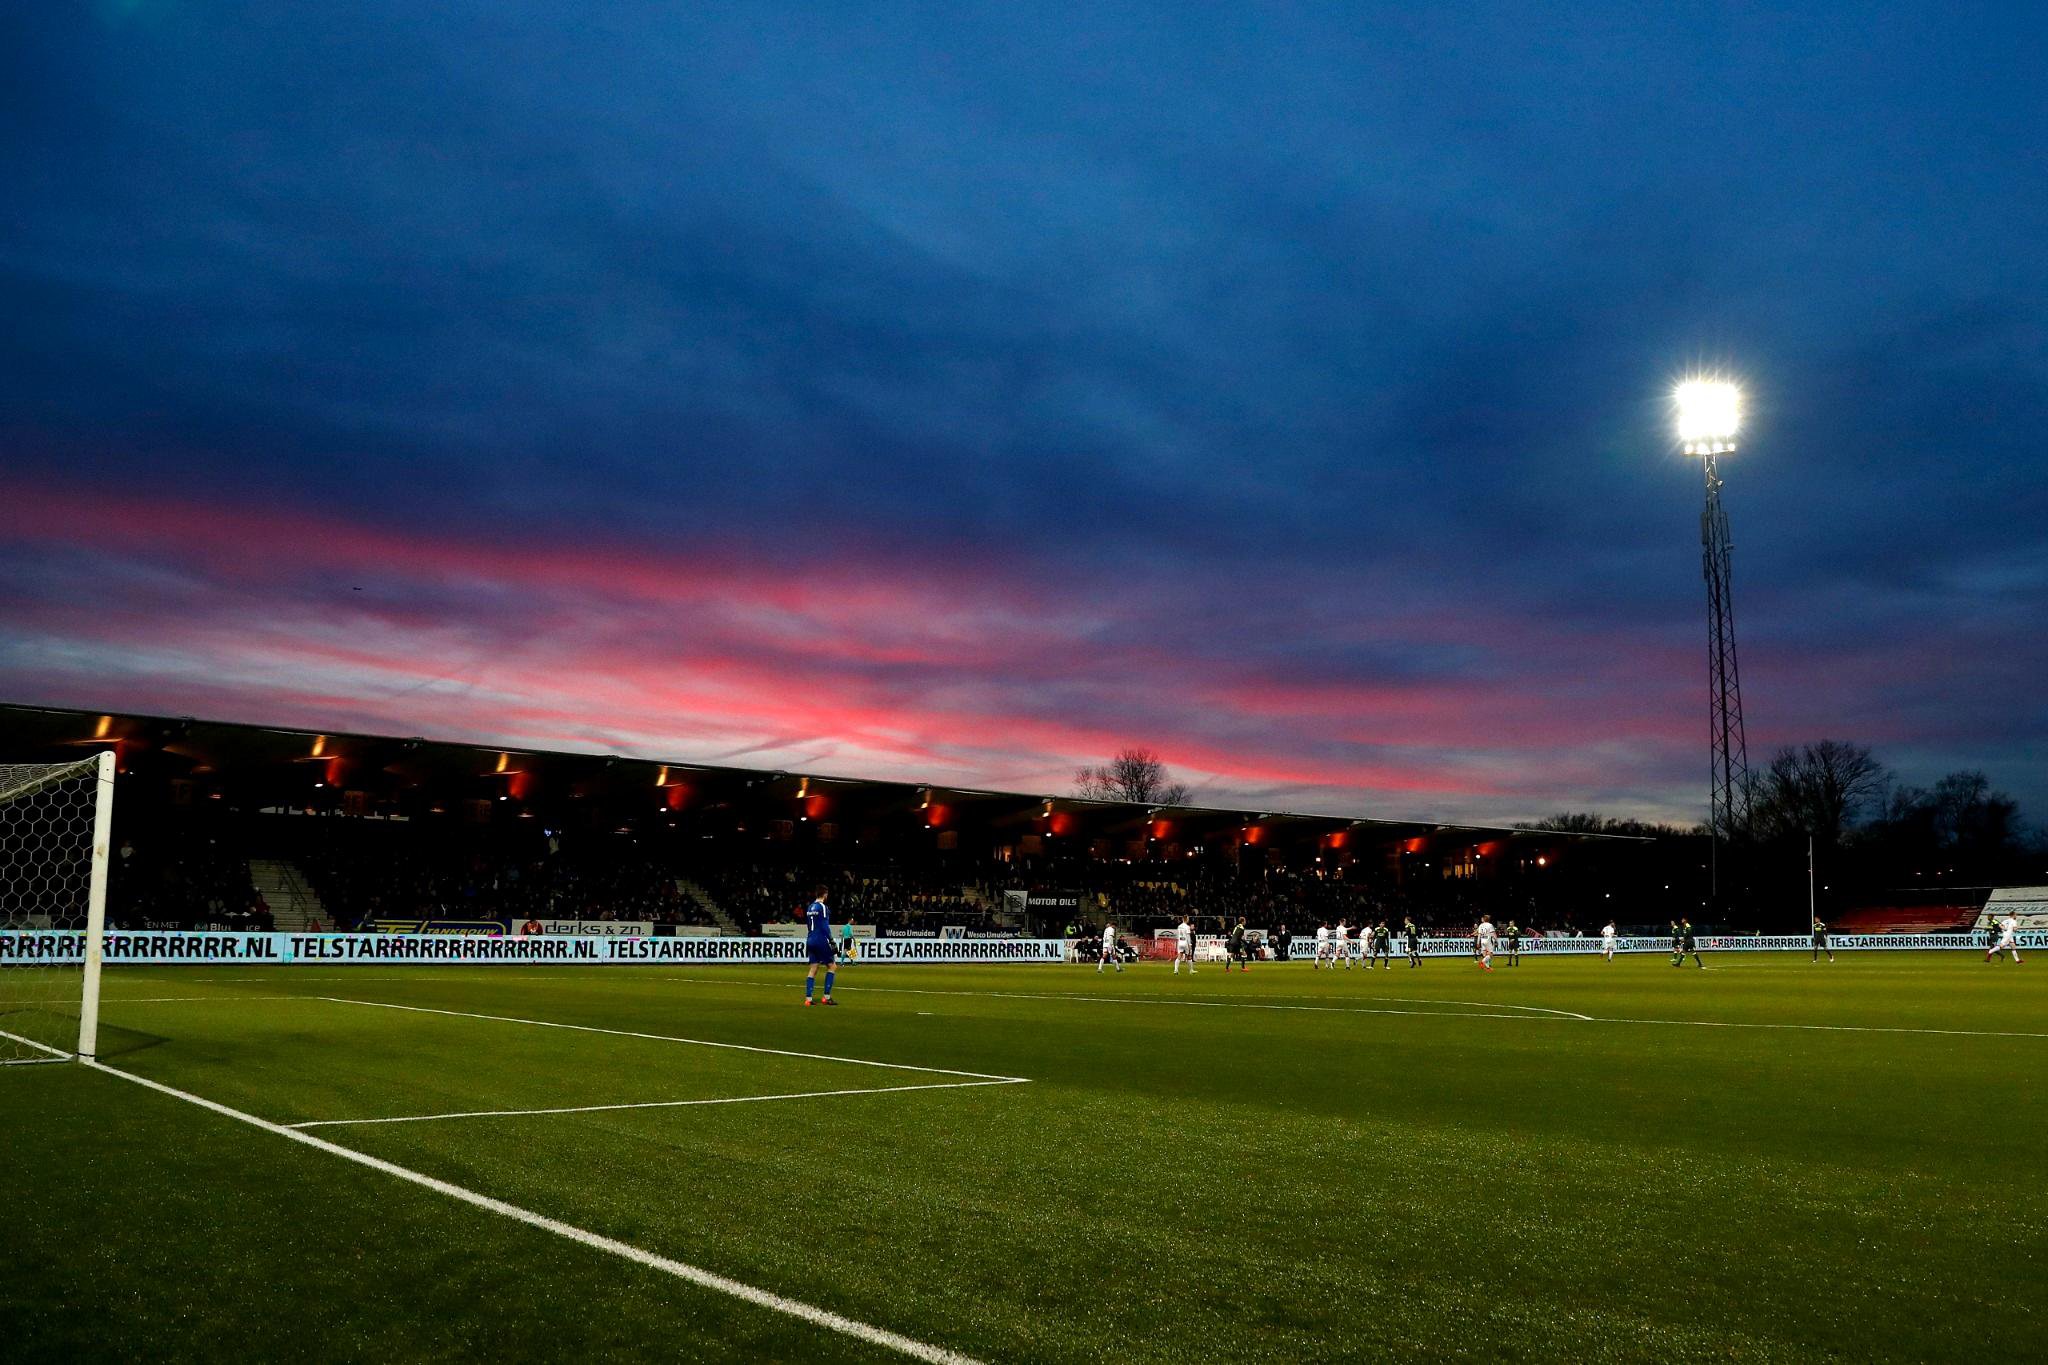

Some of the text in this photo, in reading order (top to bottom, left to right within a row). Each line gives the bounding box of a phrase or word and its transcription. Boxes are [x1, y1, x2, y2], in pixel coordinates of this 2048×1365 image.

[1028, 898, 1077, 906] MOTOR OILS
[545, 921, 645, 934] derks & zn.
[885, 929, 905, 937] Wesco
